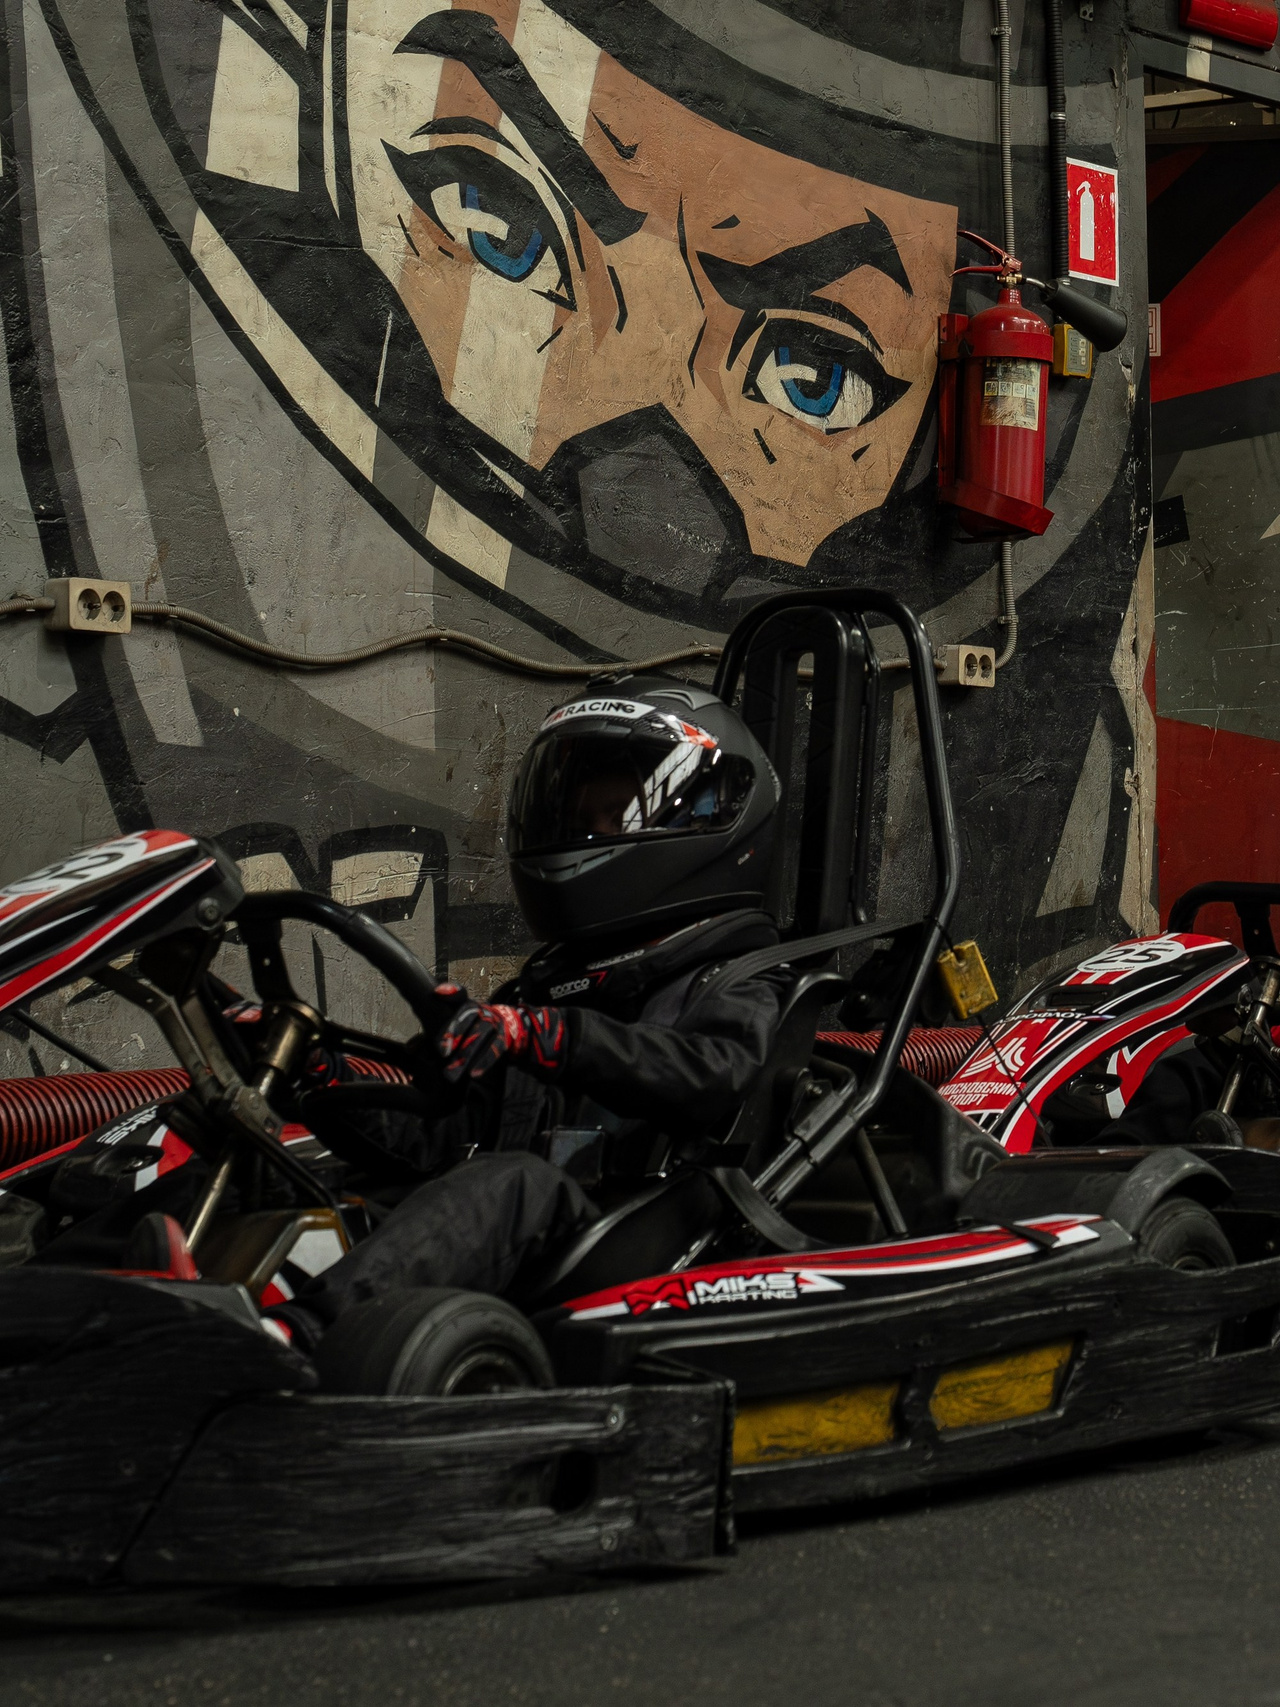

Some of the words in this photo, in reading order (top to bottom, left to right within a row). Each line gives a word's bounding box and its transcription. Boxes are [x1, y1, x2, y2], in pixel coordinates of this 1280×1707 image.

[564, 702, 636, 717] RACING
[1085, 948, 1174, 966] 25
[938, 1081, 1021, 1096] МОСКОВСКИЙ
[949, 1094, 989, 1106] СПОРТ
[694, 1272, 797, 1297] MIKS
[699, 1287, 798, 1304] KARTING
